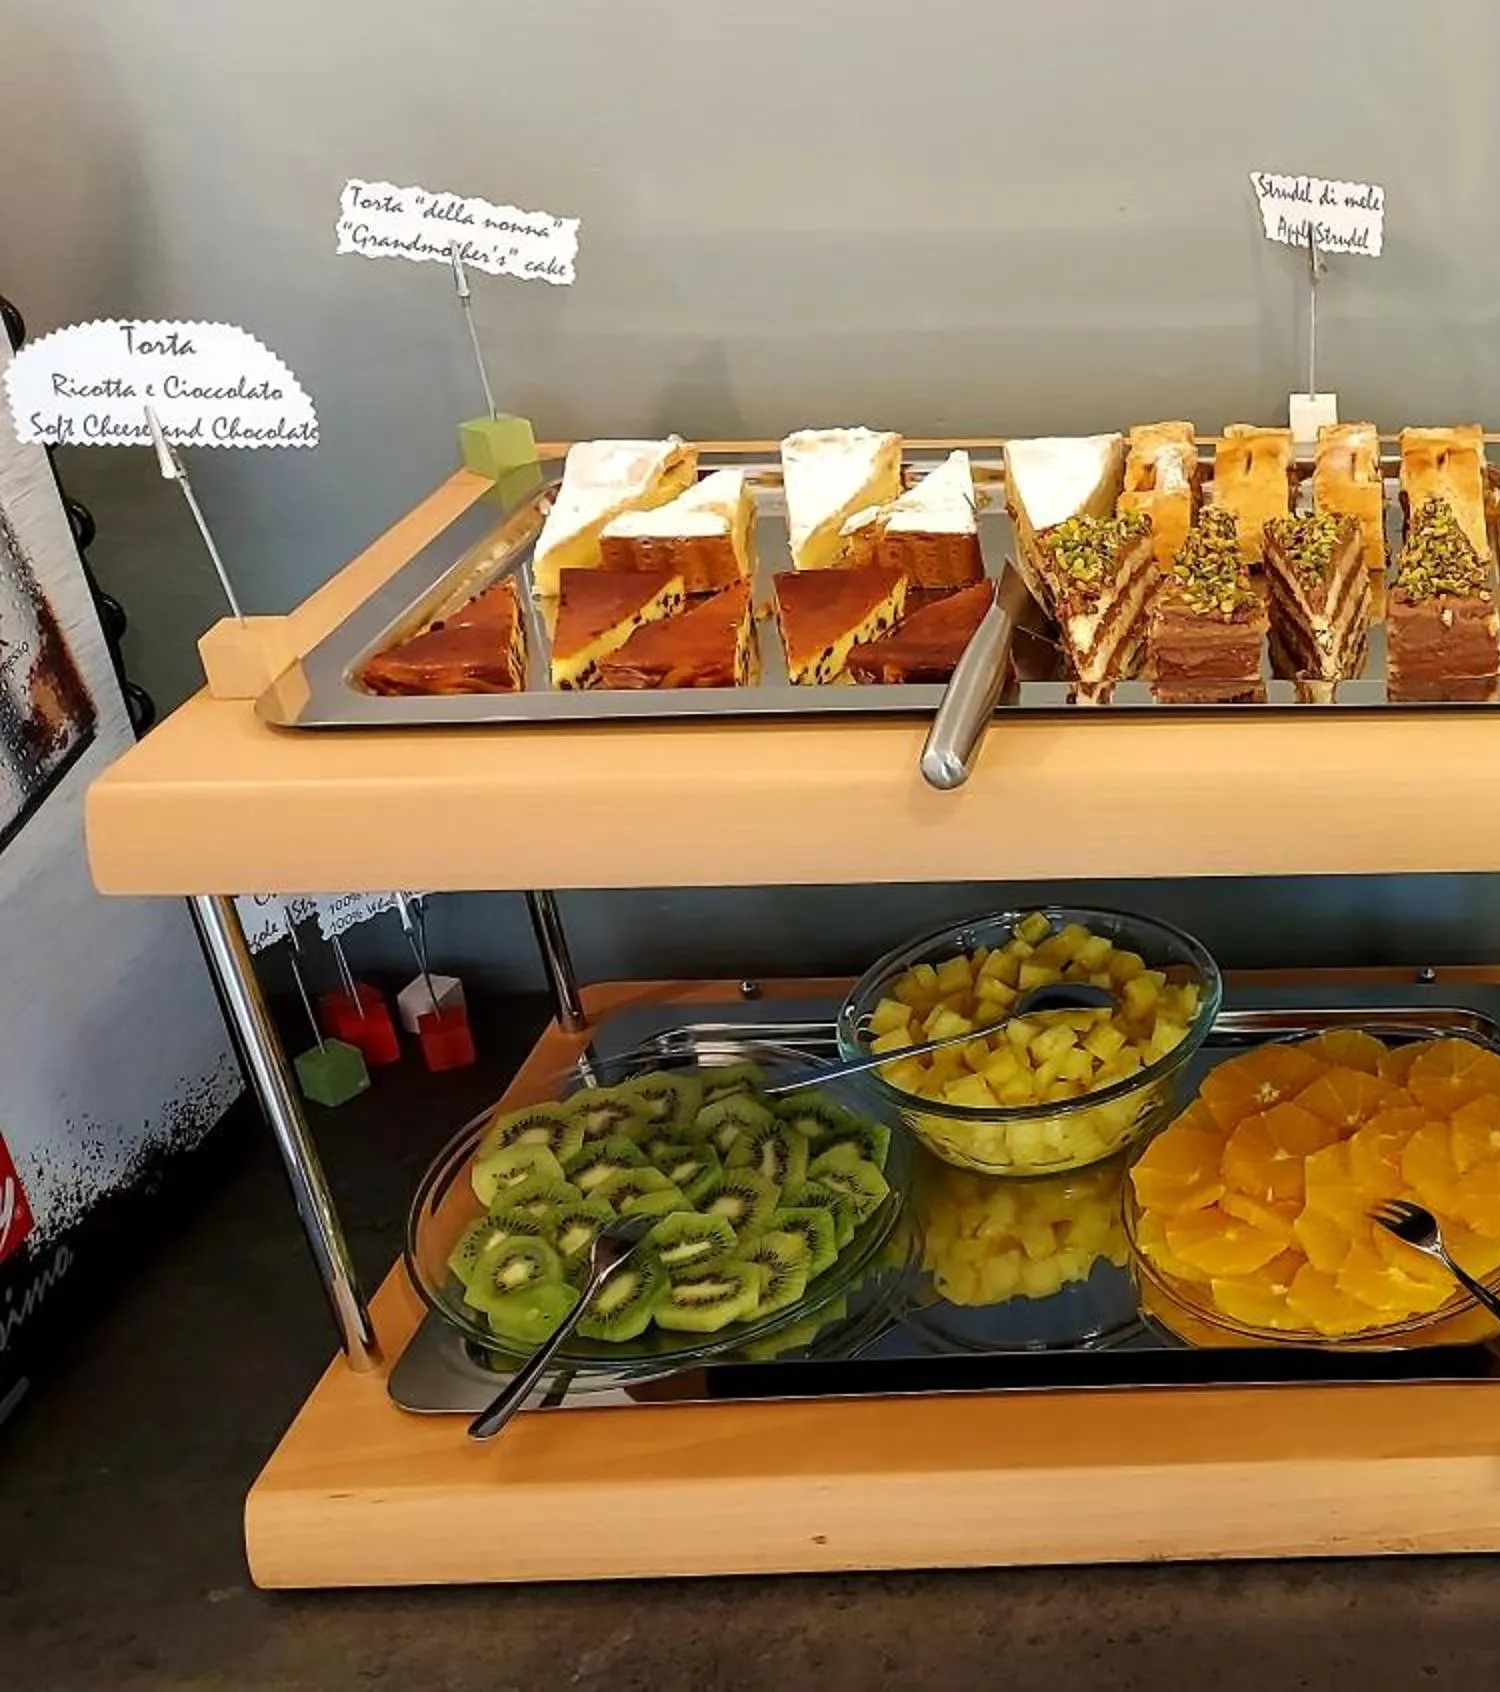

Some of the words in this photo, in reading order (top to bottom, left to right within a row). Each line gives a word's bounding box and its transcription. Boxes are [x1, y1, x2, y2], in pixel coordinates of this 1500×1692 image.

[350, 186, 404, 213] Torta
[1258, 175, 1312, 203] Strudel
[1319, 183, 1338, 206] di
[1344, 187, 1380, 211] mele
[1277, 215, 1312, 246] Appl
[1315, 221, 1369, 249] Strudel
[524, 256, 567, 276] cake
[120, 325, 197, 356] Torta
[51, 373, 137, 399] Ricotta
[146, 383, 155, 397] e
[164, 375, 283, 401] Cioccolato
[30, 411, 74, 444] Soft
[83, 413, 151, 438] Cheese
[161, 418, 204, 439] and
[212, 416, 318, 441] Chocolate
